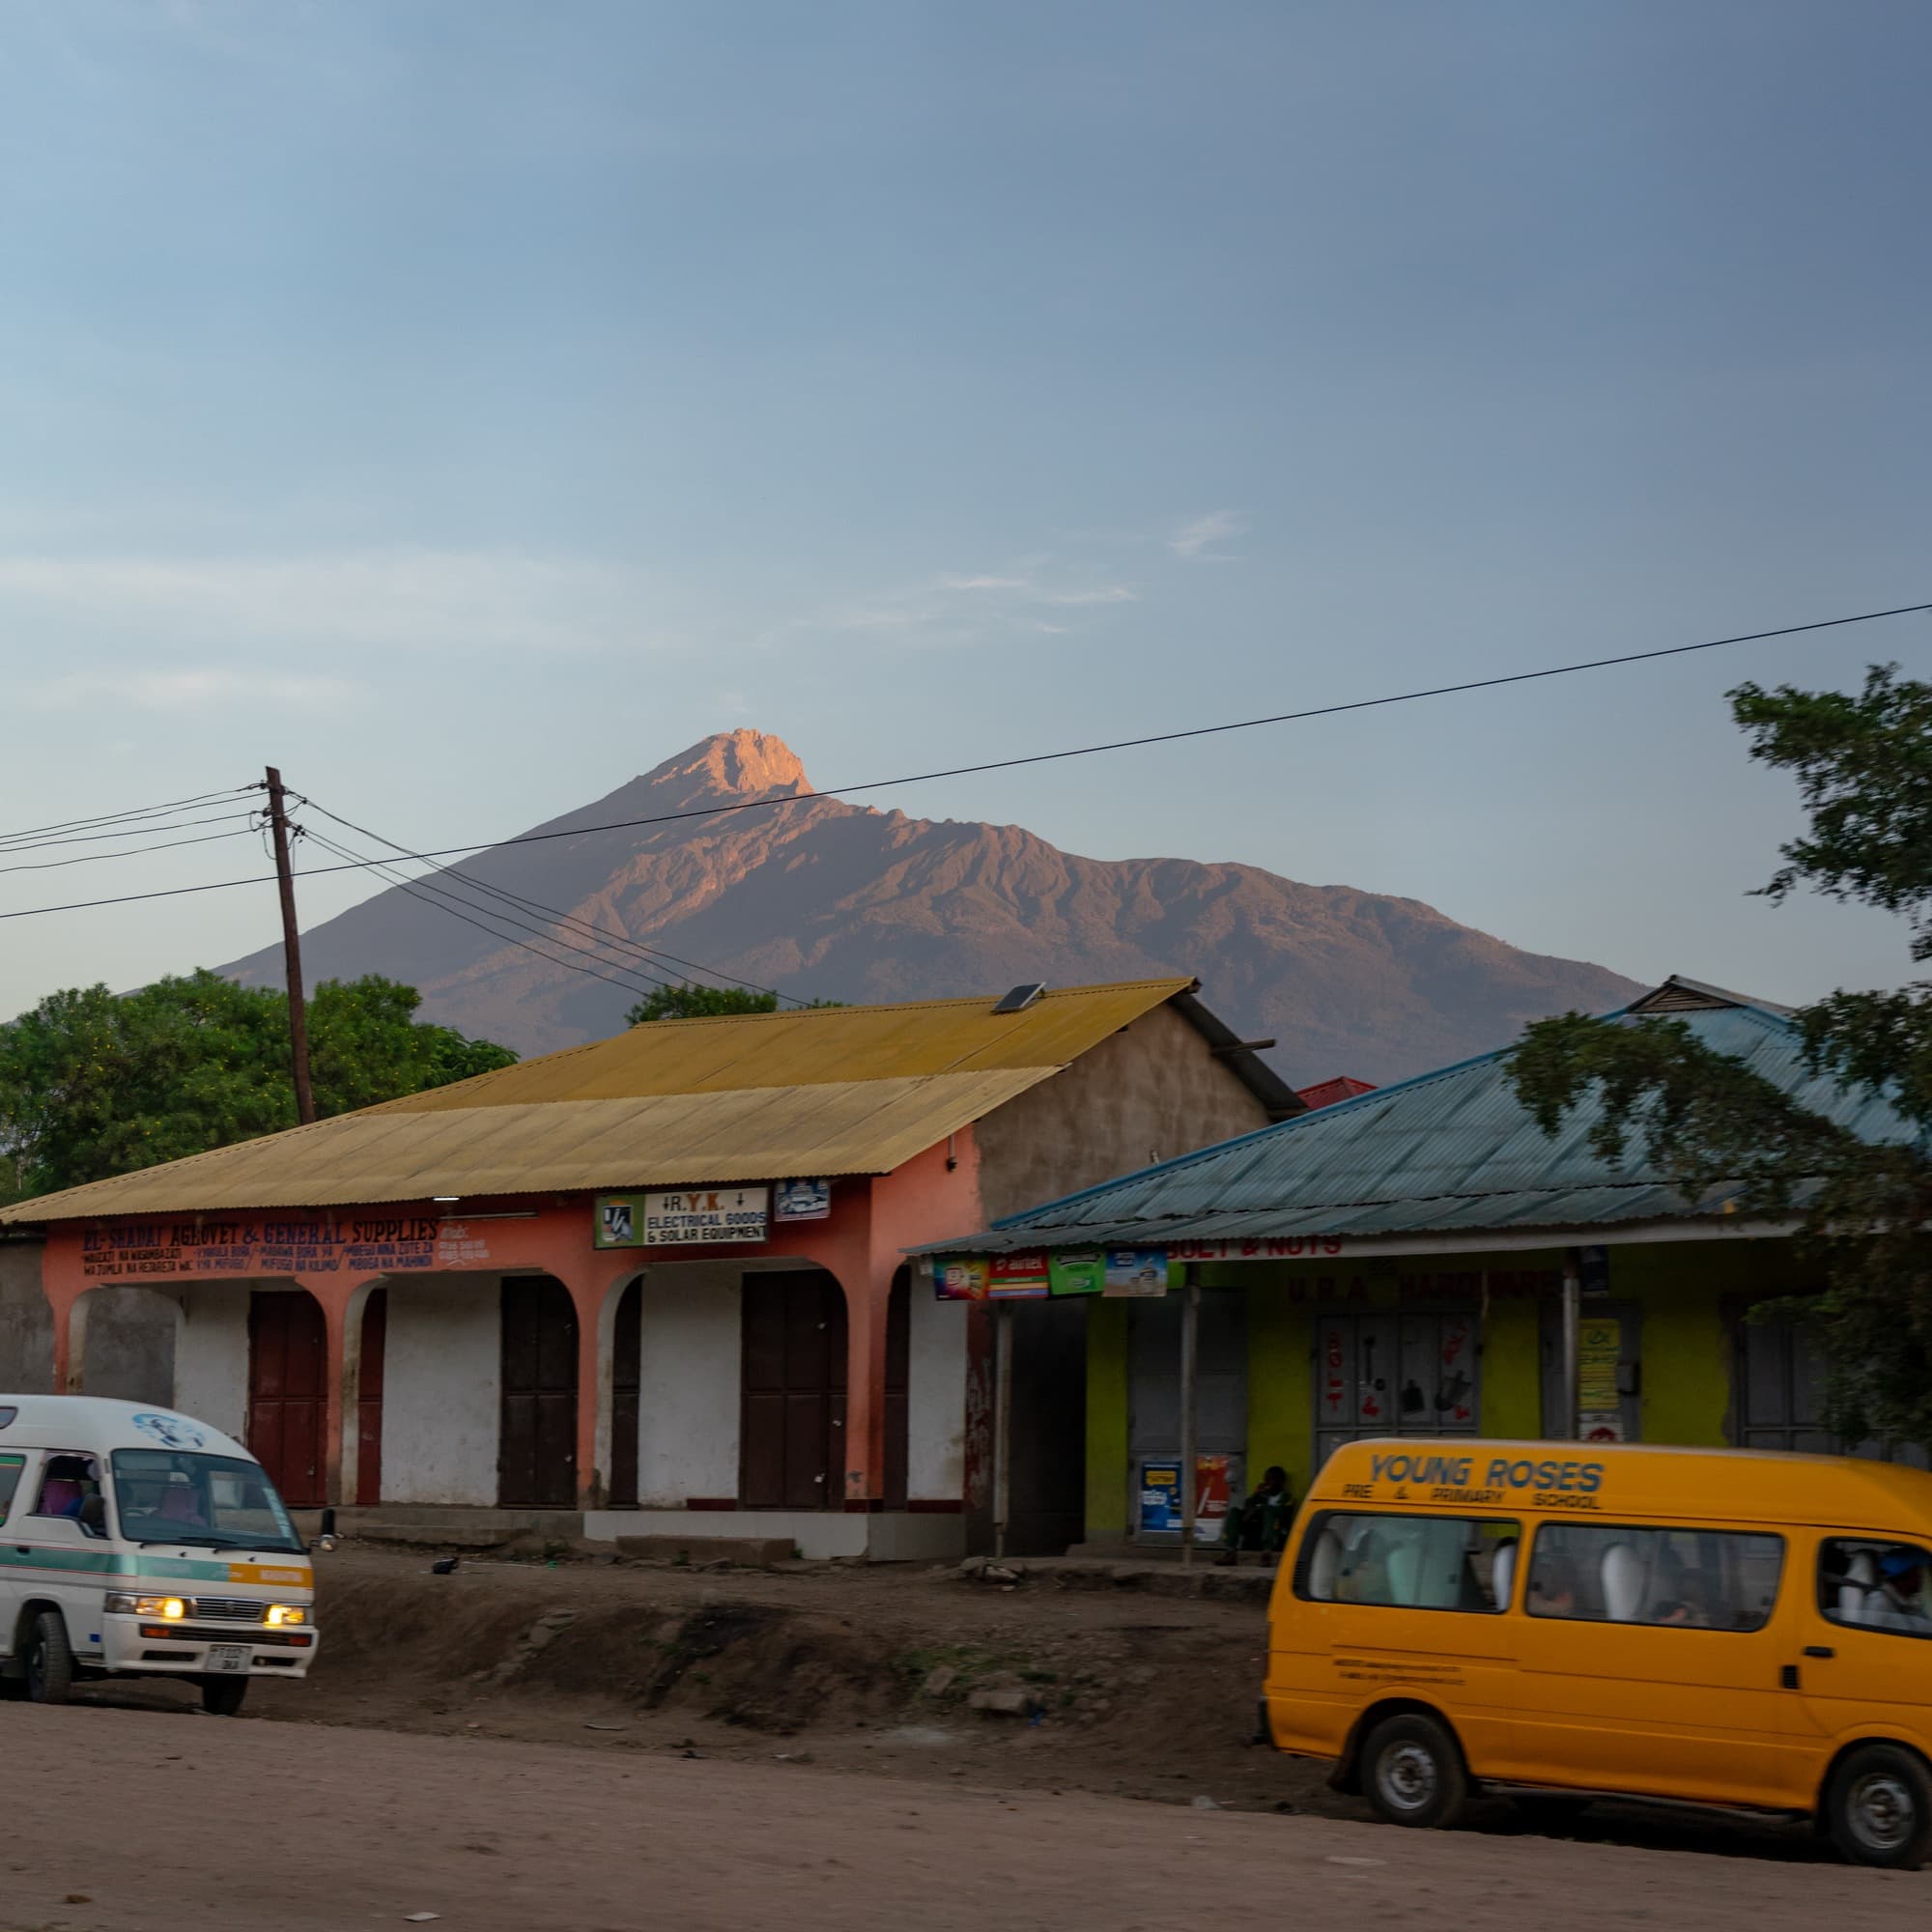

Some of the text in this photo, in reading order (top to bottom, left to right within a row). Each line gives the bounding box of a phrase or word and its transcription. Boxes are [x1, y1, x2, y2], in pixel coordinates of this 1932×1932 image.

[648, 1211, 767, 1229] ELECTRICAL GOODS
[243, 1222, 259, 1244] &
[264, 1221, 346, 1244] GENERAL
[352, 1218, 440, 1242] SUPPLIES
[660, 1228, 697, 1241] SOLAR
[702, 1225, 767, 1240] EQUIPMENT
[1266, 1236, 1343, 1256] NUTS
[1008, 1255, 1044, 1270] airtel
[1370, 1454, 1604, 1492] YOUNG ROSES
[1342, 1484, 1373, 1498] PRE
[1429, 1488, 1506, 1503] PRIMARY
[1532, 1492, 1601, 1509] SCHOOL
